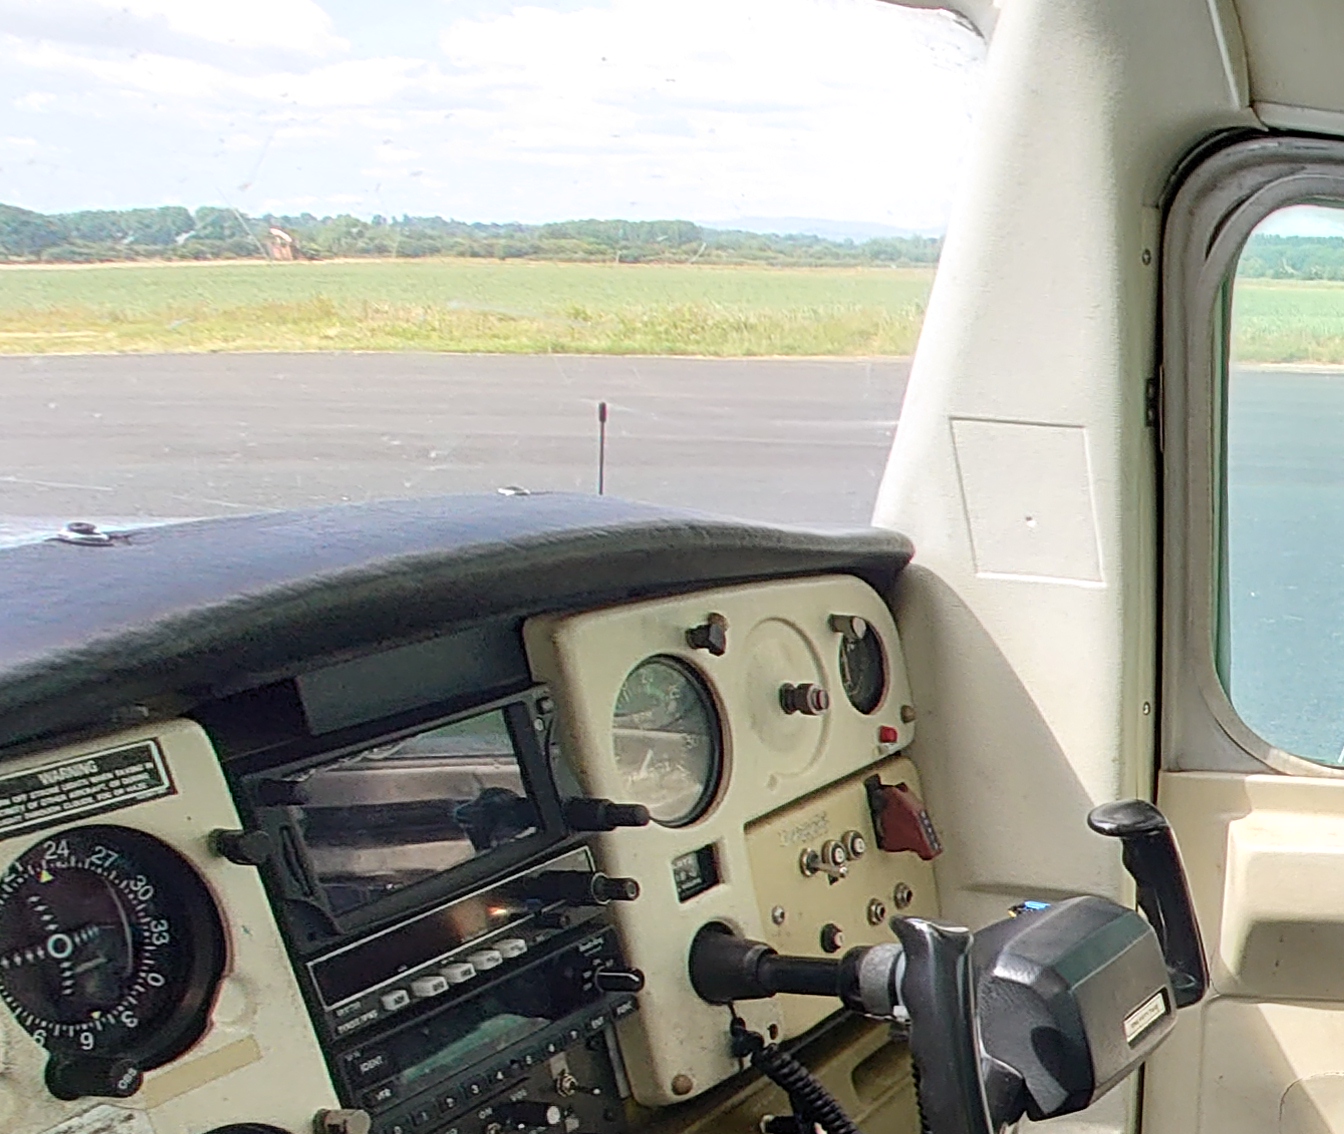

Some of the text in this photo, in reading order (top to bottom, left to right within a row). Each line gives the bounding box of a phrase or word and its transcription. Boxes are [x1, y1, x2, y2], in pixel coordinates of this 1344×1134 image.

[43, 840, 69, 860] 24
[90, 846, 118, 866] 27
[131, 874, 154, 900] 30
[150, 919, 170, 945] 33
